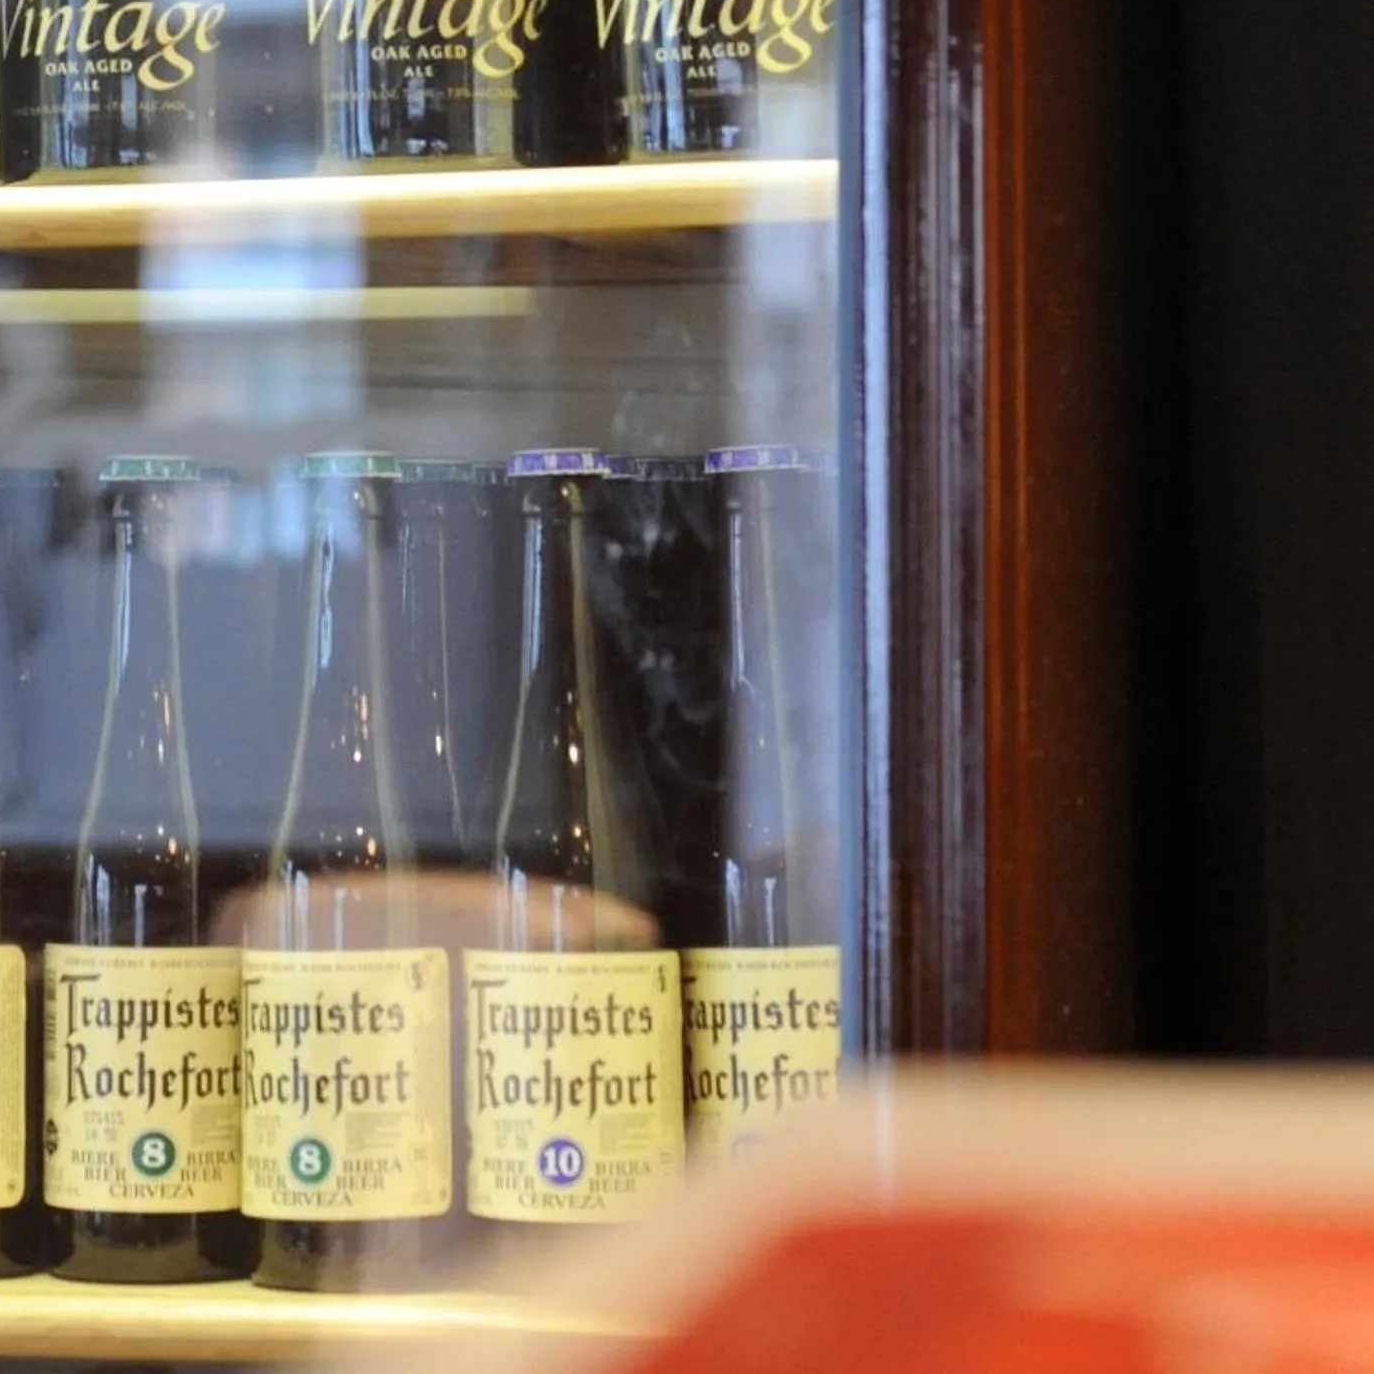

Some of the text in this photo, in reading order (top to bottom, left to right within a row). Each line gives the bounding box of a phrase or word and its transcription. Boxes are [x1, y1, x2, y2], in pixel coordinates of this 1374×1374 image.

[44, 59, 133, 76] OAK AGED
[371, 44, 468, 61] OAK AGED
[655, 42, 751, 63] OAK AGED
[72, 80, 101, 93] ALE
[404, 65, 435, 79] ALE
[686, 65, 718, 79] ALE
[60, 974, 239, 1045] Trappistes
[243, 977, 405, 1049] Trappistes
[471, 979, 654, 1049] Trappistes
[682, 976, 840, 1045] rappistes
[65, 1041, 241, 1114] Rochefort
[243, 1048, 409, 1119] Rochefort
[476, 1047, 657, 1121] Rochefort
[684, 1046, 841, 1114] ochefor
[141, 1137, 166, 1168] 8
[186, 1151, 237, 1166] BIRRA
[298, 1144, 322, 1175] 8
[541, 1146, 582, 1177] 10
[180, 1167, 223, 1183] BEER
[109, 1183, 194, 1199] CERVEZA
